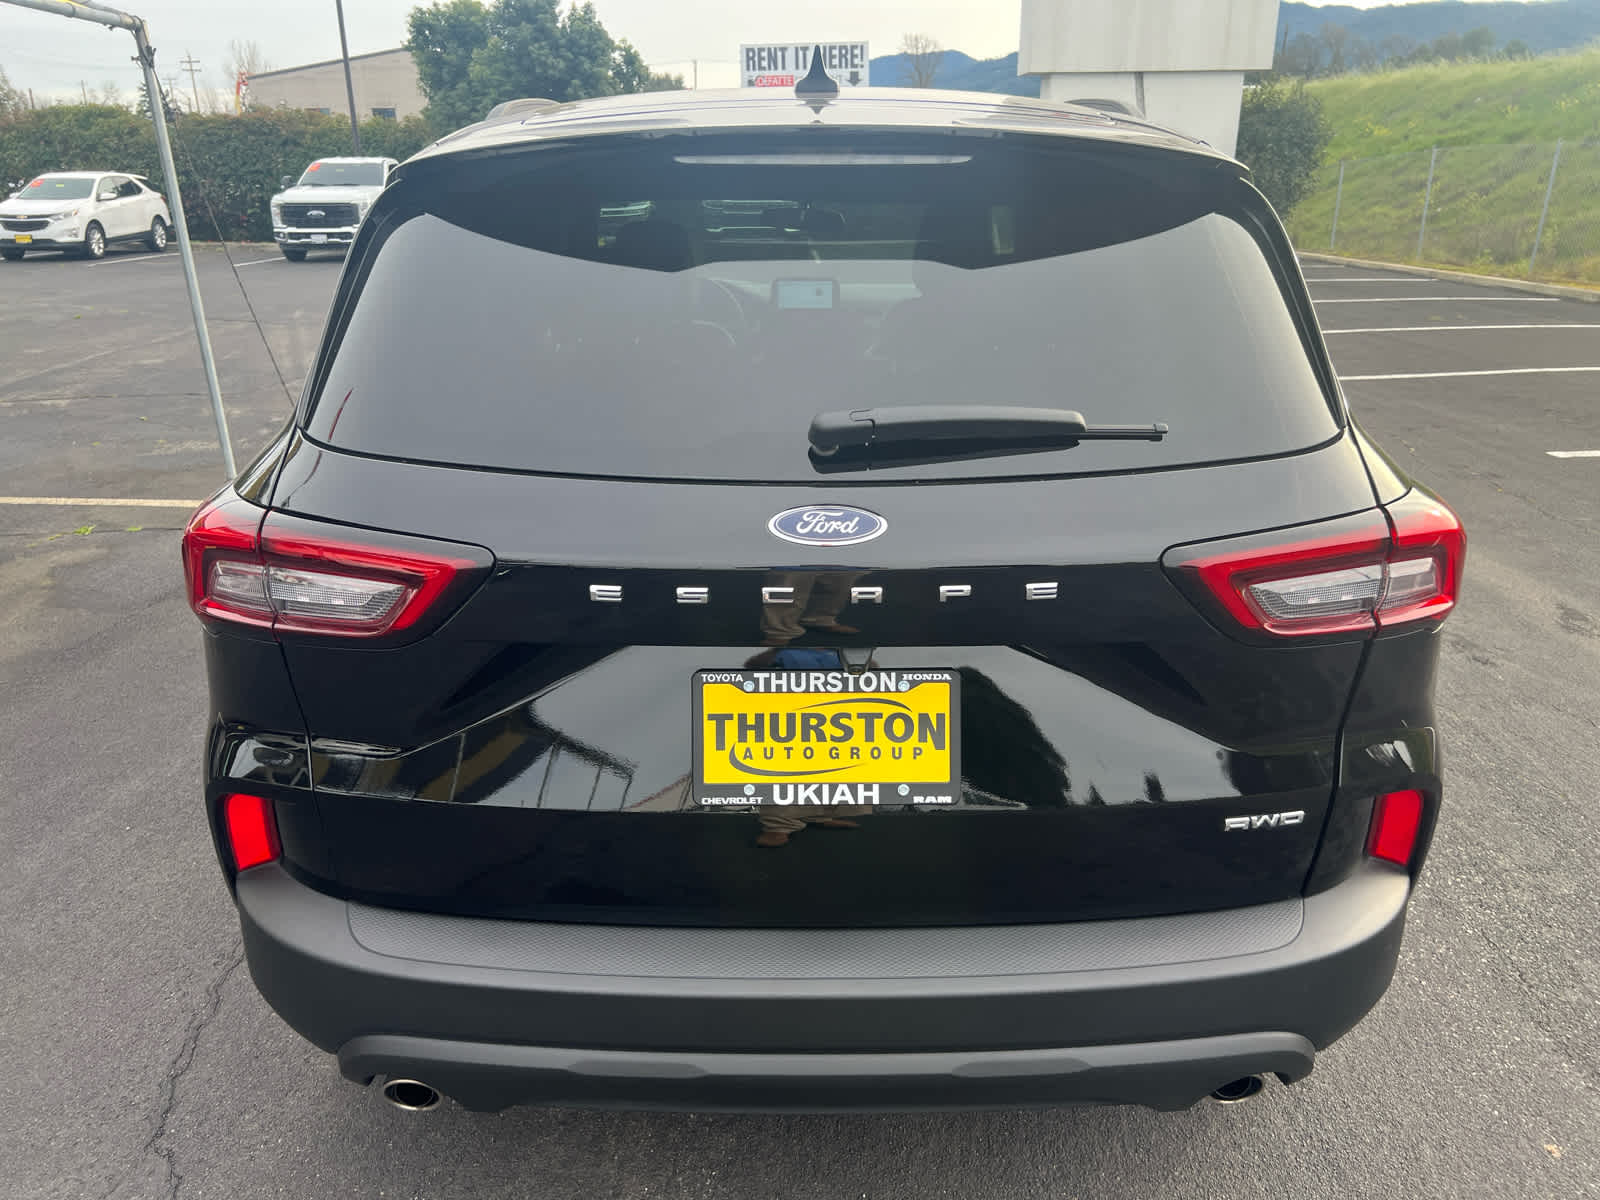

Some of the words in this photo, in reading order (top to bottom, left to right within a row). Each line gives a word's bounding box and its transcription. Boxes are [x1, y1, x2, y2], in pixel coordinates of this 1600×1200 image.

[745, 46, 788, 71] RENT
[794, 45, 810, 70] IT
[796, 511, 860, 534] Ford
[589, 582, 1059, 604] ESCAPE
[701, 673, 743, 682] TOYOTA
[753, 672, 897, 693] THURSTON
[902, 673, 952, 681] HONDA
[707, 712, 946, 751] THURSTON
[701, 796, 764, 805] CHEVROLET
[772, 783, 880, 805] UKIAH
[913, 795, 952, 804] RAM
[1224, 810, 1305, 832] AWD
